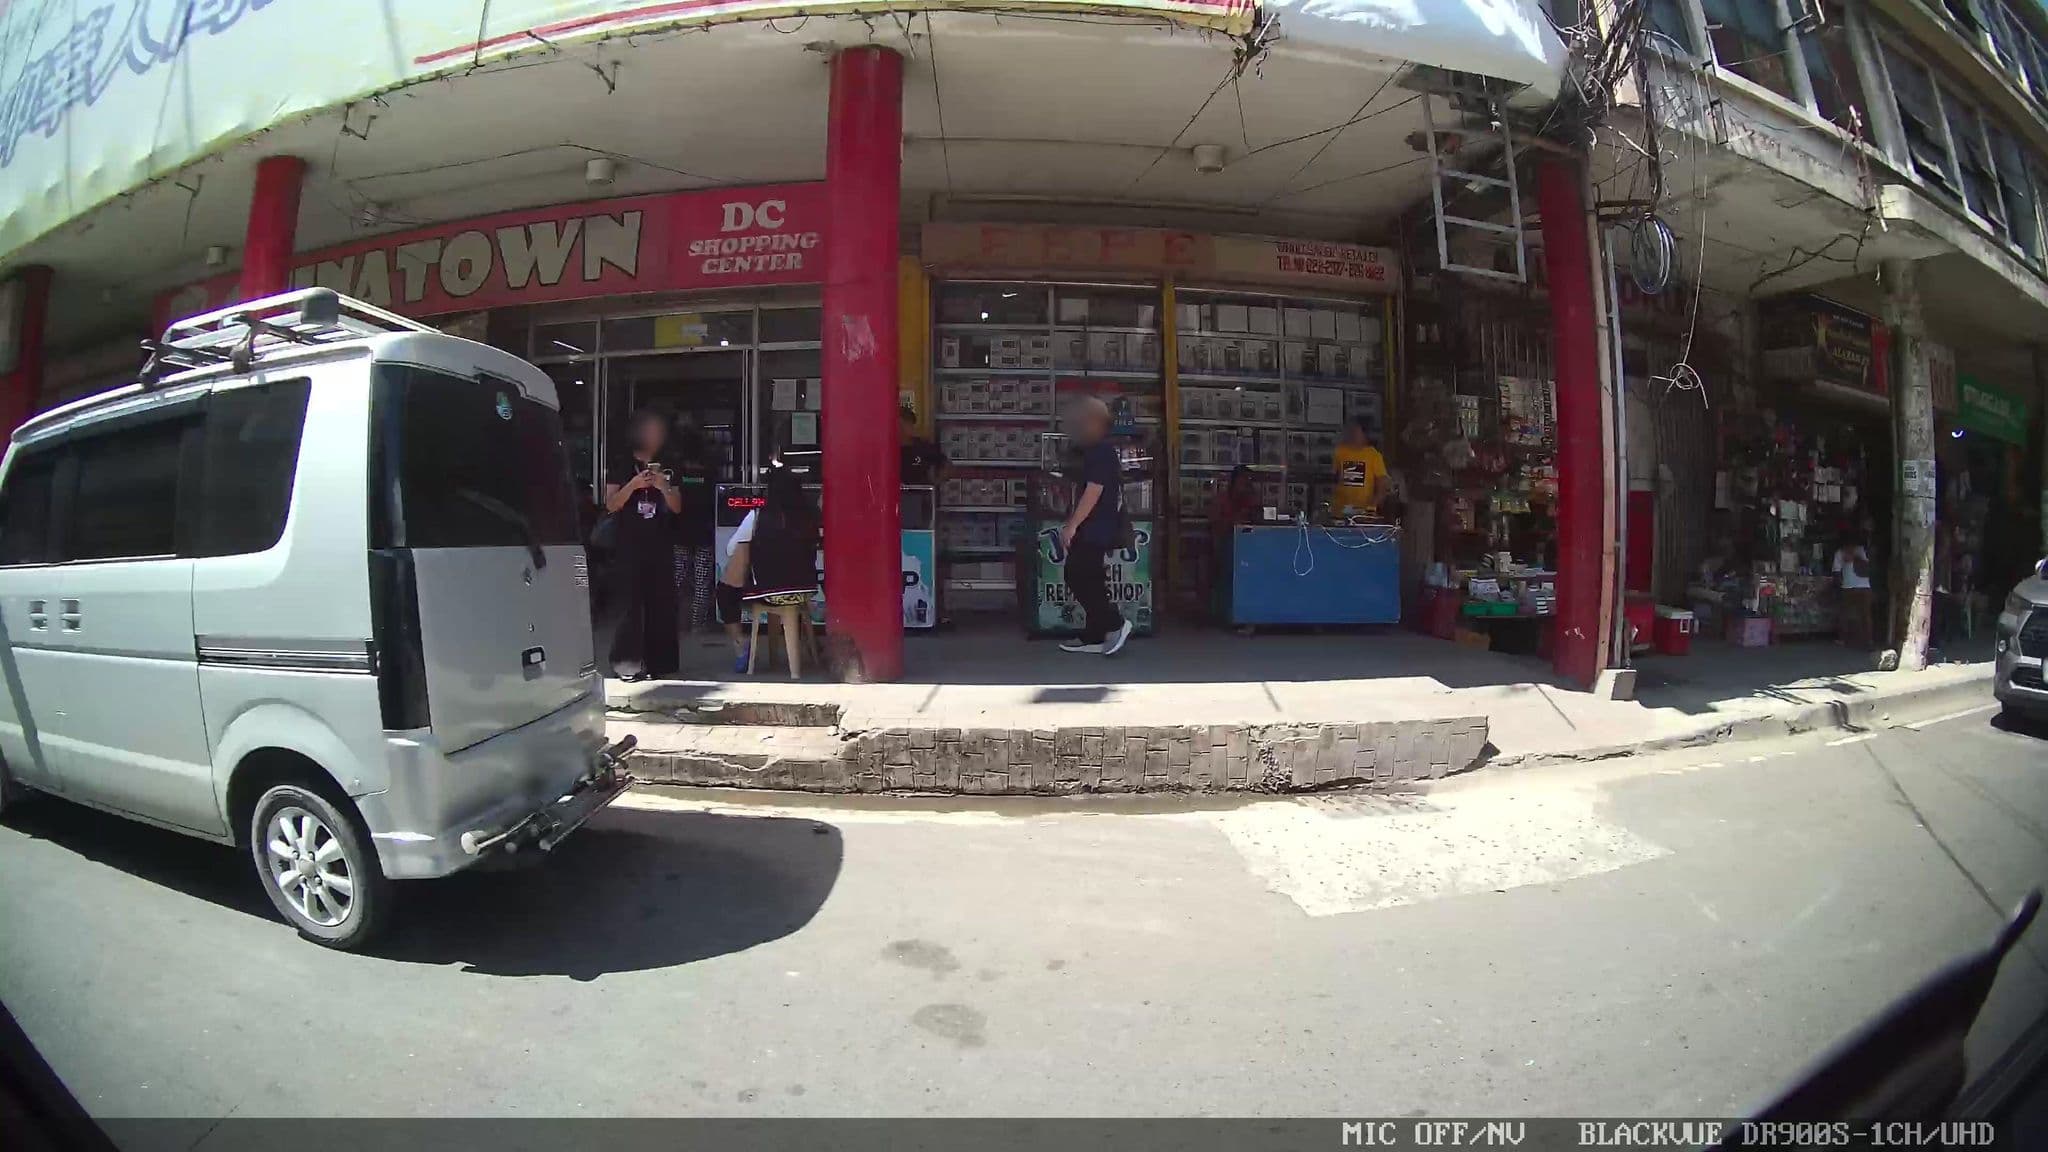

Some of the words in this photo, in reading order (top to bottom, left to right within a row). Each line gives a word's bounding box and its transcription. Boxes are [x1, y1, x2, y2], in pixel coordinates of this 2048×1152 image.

[721, 199, 786, 232] DC
[688, 231, 820, 257] SHOPPING
[702, 252, 803, 274] CENTER
